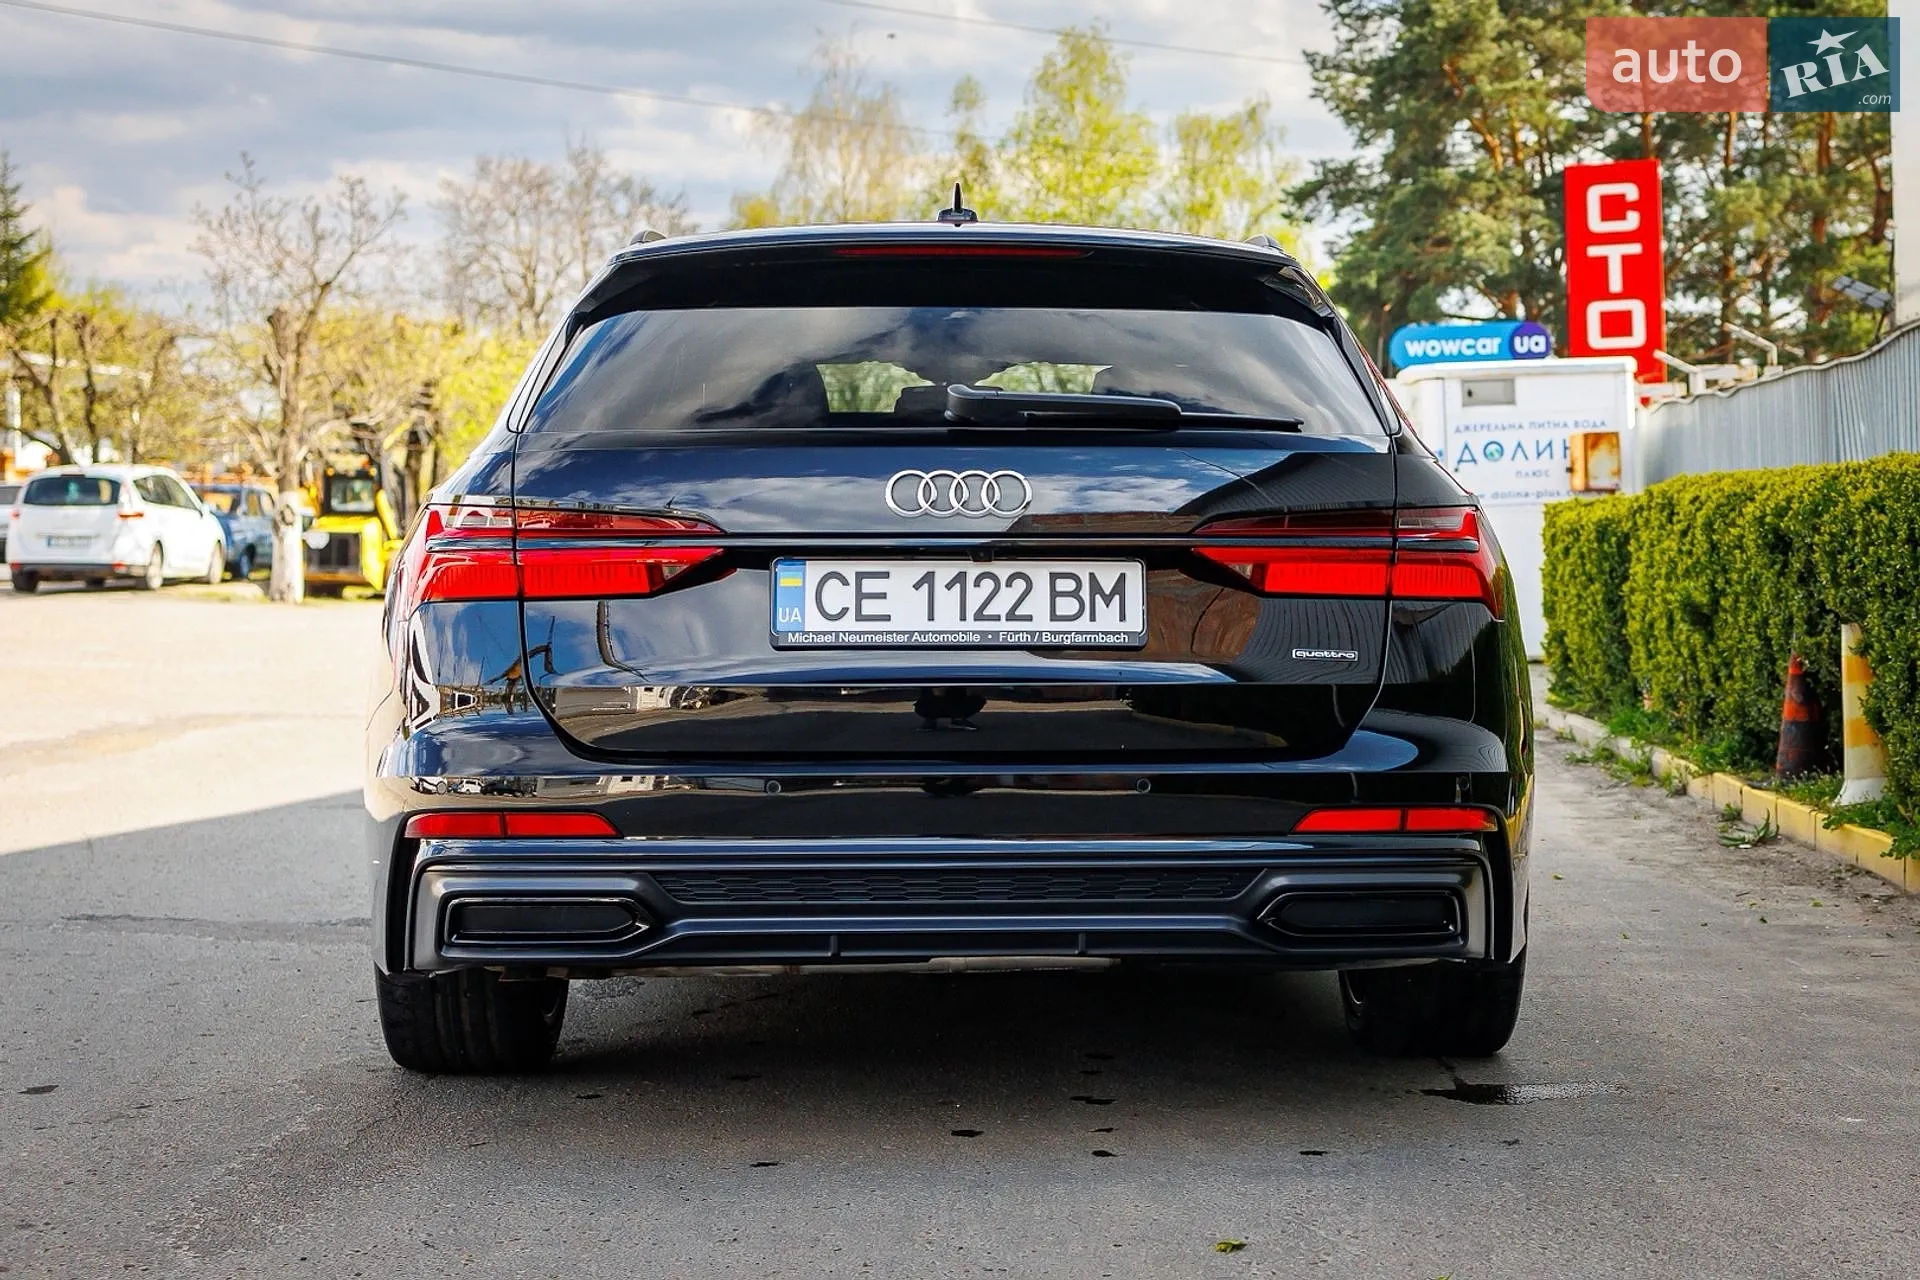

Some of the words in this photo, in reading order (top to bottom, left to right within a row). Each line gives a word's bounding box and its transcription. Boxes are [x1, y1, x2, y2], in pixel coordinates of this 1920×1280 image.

[1586, 183, 1647, 350] СТО
[1404, 336, 1501, 358] wowcar
[1513, 333, 1547, 354] ua
[1454, 423, 1524, 434] ДЖЕРЕЛЬНА
[1529, 420, 1569, 431] ПИТНА
[1573, 419, 1608, 430] ВОДА
[1454, 438, 1571, 472] ДОЛИН
[815, 571, 891, 623] CE
[912, 571, 1033, 623] 1122
[1048, 571, 1126, 623] BM
[778, 607, 802, 623] UA
[787, 632, 835, 643] Michael
[839, 632, 909, 643] Neumeister
[911, 632, 981, 643] Automobile
[999, 632, 1031, 643] Fürth
[1296, 650, 1355, 659] quattro
